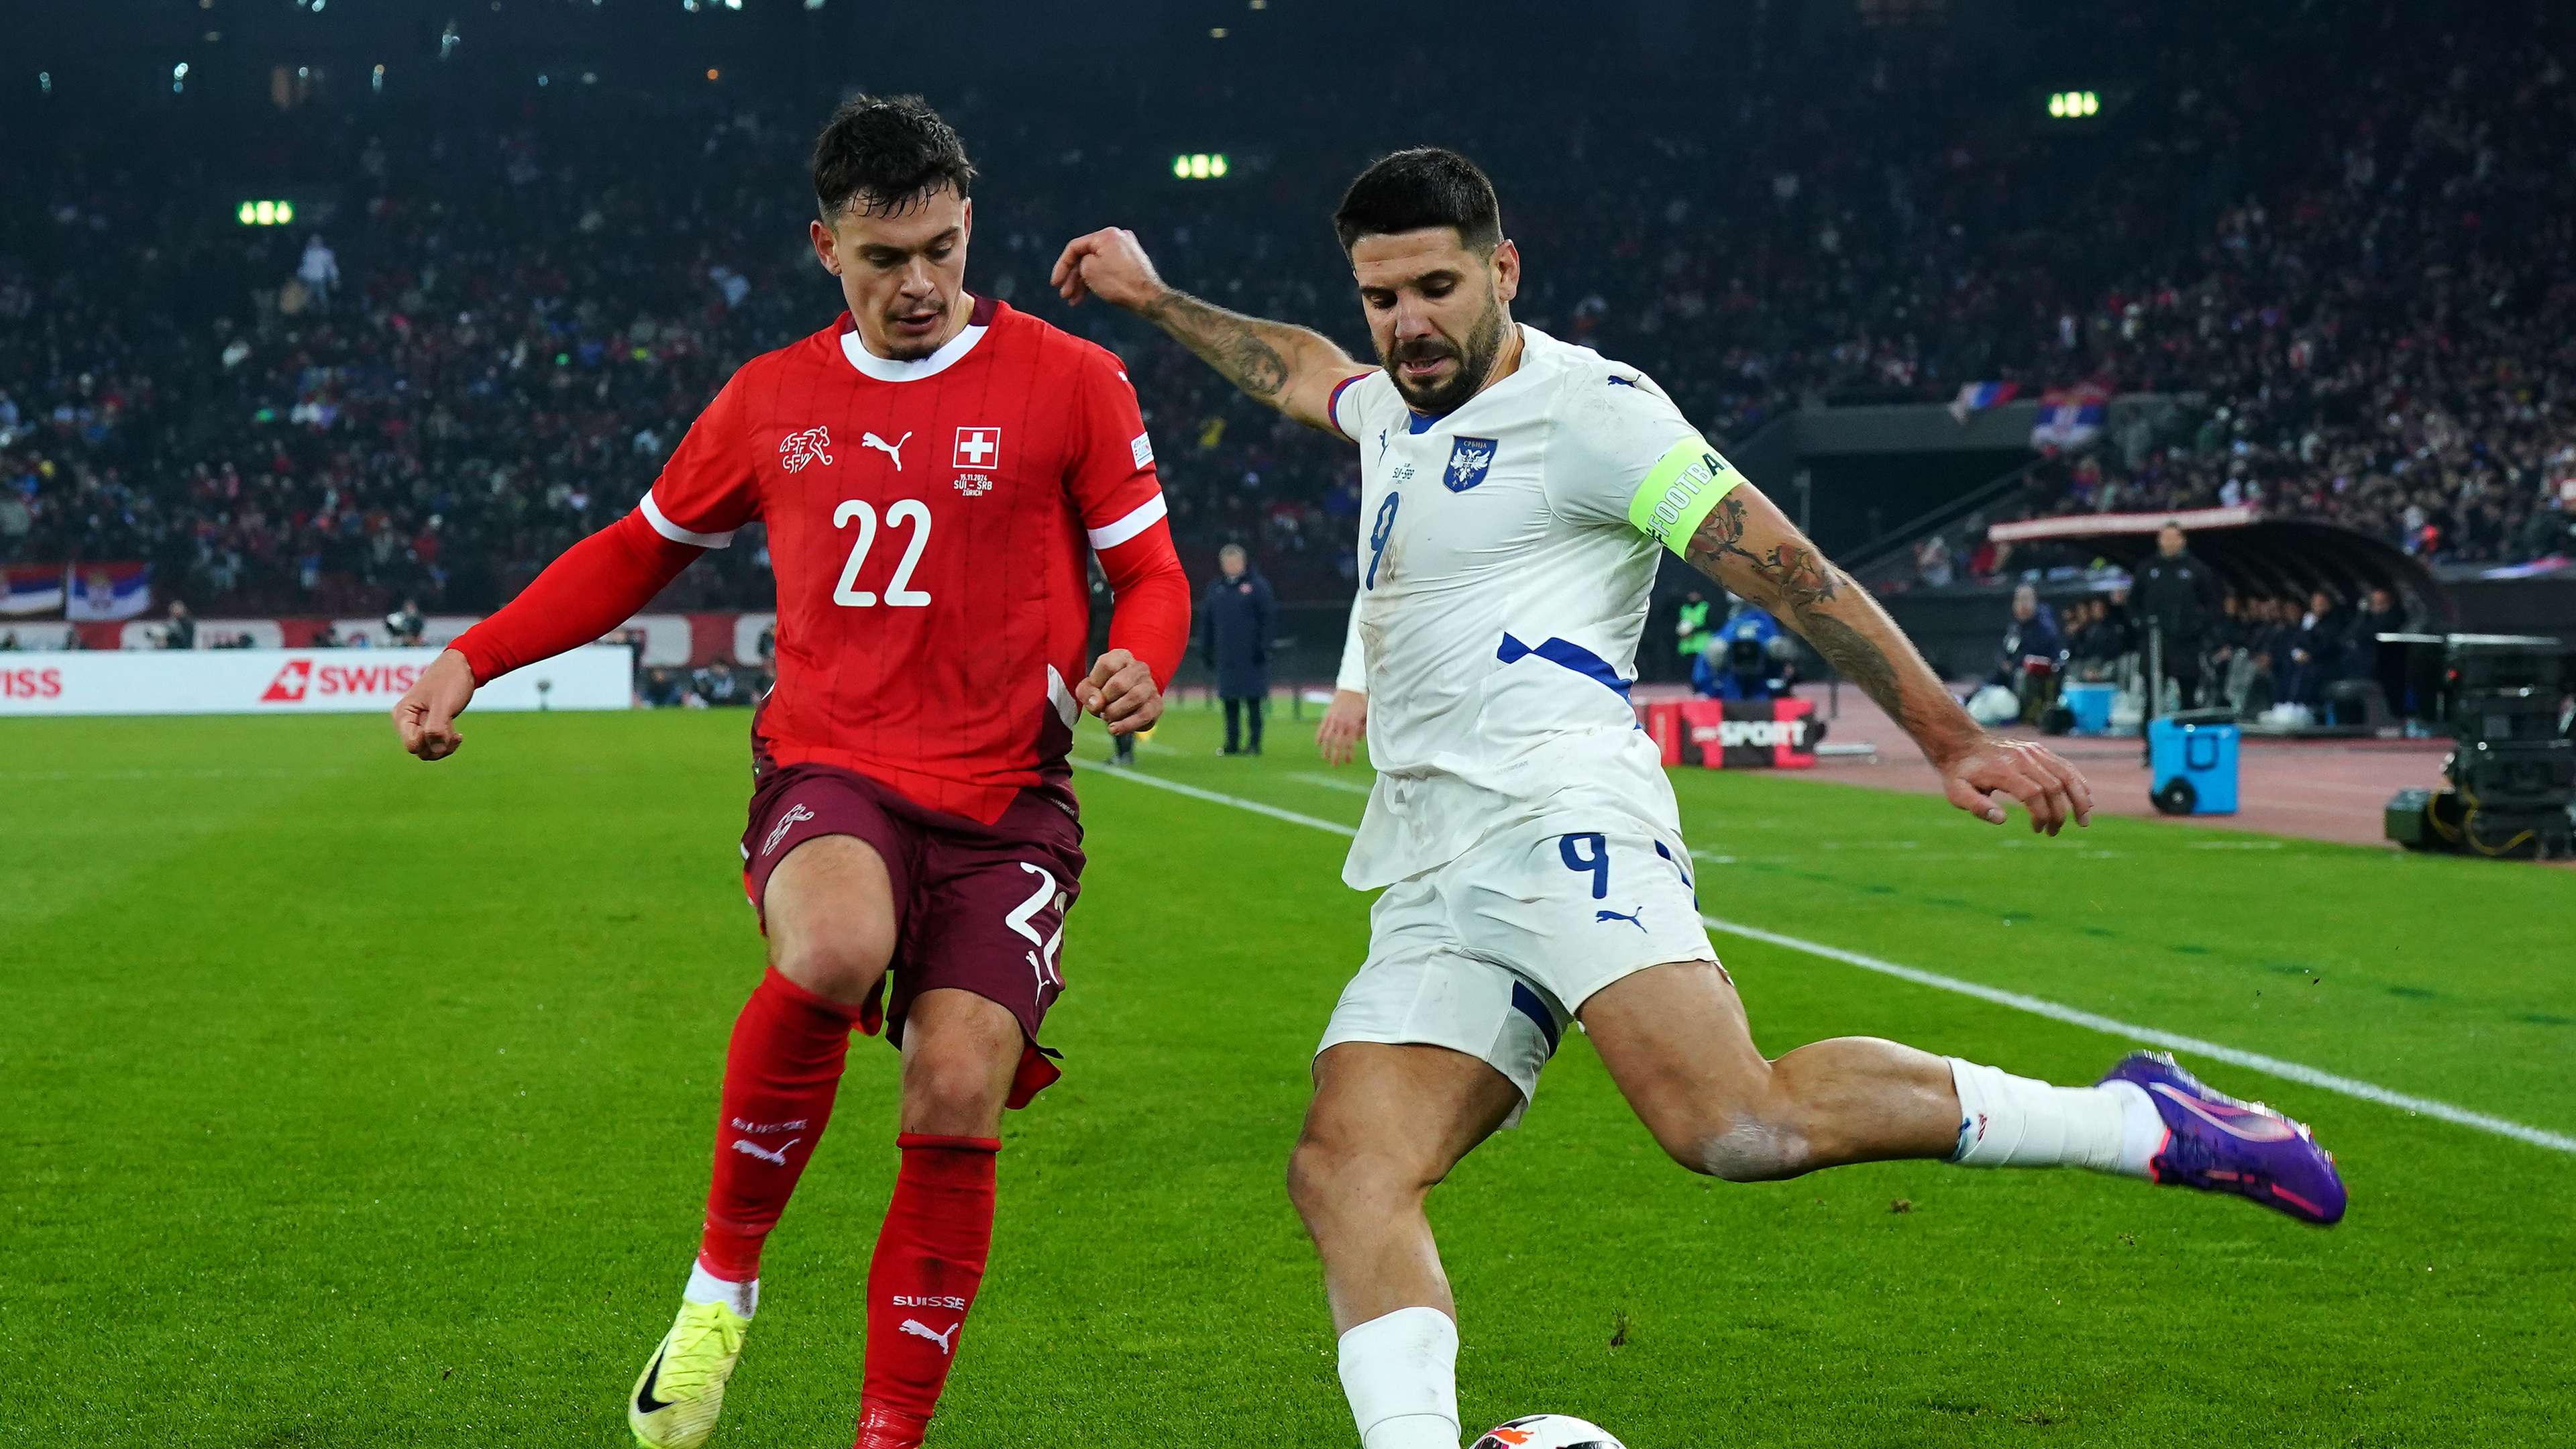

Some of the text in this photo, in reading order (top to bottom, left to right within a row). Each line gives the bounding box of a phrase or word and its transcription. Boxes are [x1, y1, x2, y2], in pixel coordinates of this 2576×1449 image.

[953, 480, 967, 489] SUI
[977, 481, 992, 490] SRB
[1646, 451, 1727, 546] #FOOTBA
[833, 498, 932, 606] 22
[1366, 492, 1399, 590] 9
[0, 667, 61, 699] ISS
[319, 665, 431, 694] SWIS
[1719, 720, 1805, 747] SPORT
[1559, 833, 1609, 900] 9
[731, 1117, 808, 1134] SUISSE
[893, 1295, 965, 1311] SUISSE
